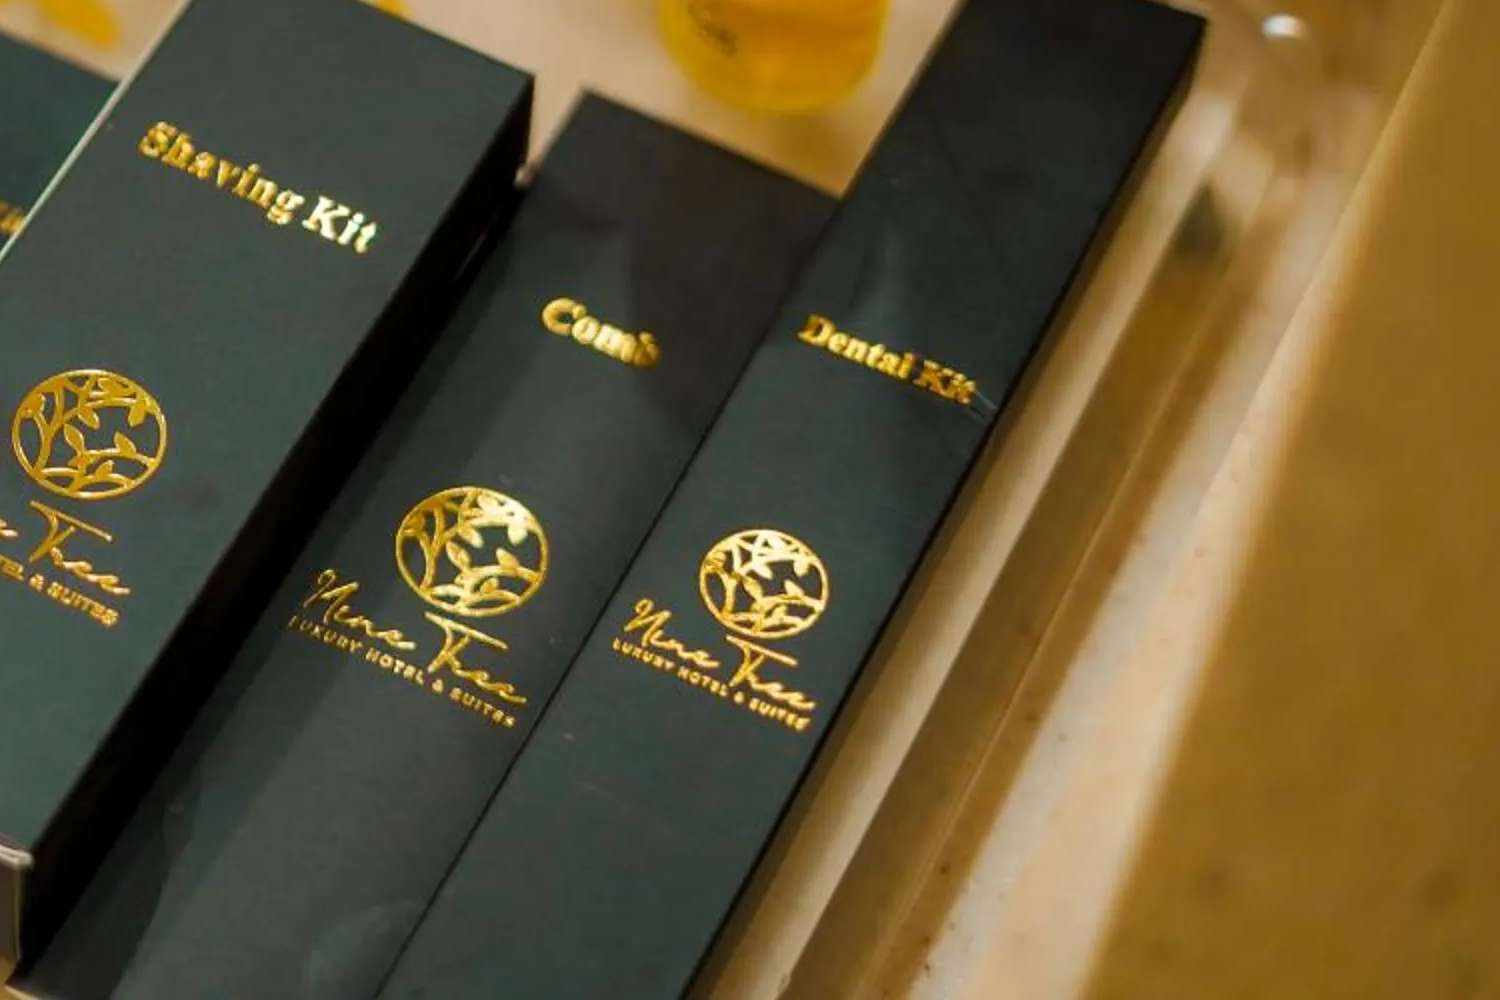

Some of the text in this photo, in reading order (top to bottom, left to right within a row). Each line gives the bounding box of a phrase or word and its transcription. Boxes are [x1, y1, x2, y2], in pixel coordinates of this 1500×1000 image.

[137, 121, 378, 253] Shaving Kit
[797, 313, 976, 405] Dental Kit
[28, 572, 46, 592] &
[47, 581, 119, 628] SUITES
[287, 615, 364, 654] LUXURY
[365, 646, 426, 685] HOTEL
[449, 686, 517, 727] SUITES
[611, 637, 676, 671] LUXURY
[677, 664, 728, 698] HOTEL
[749, 698, 811, 732] SUITES
